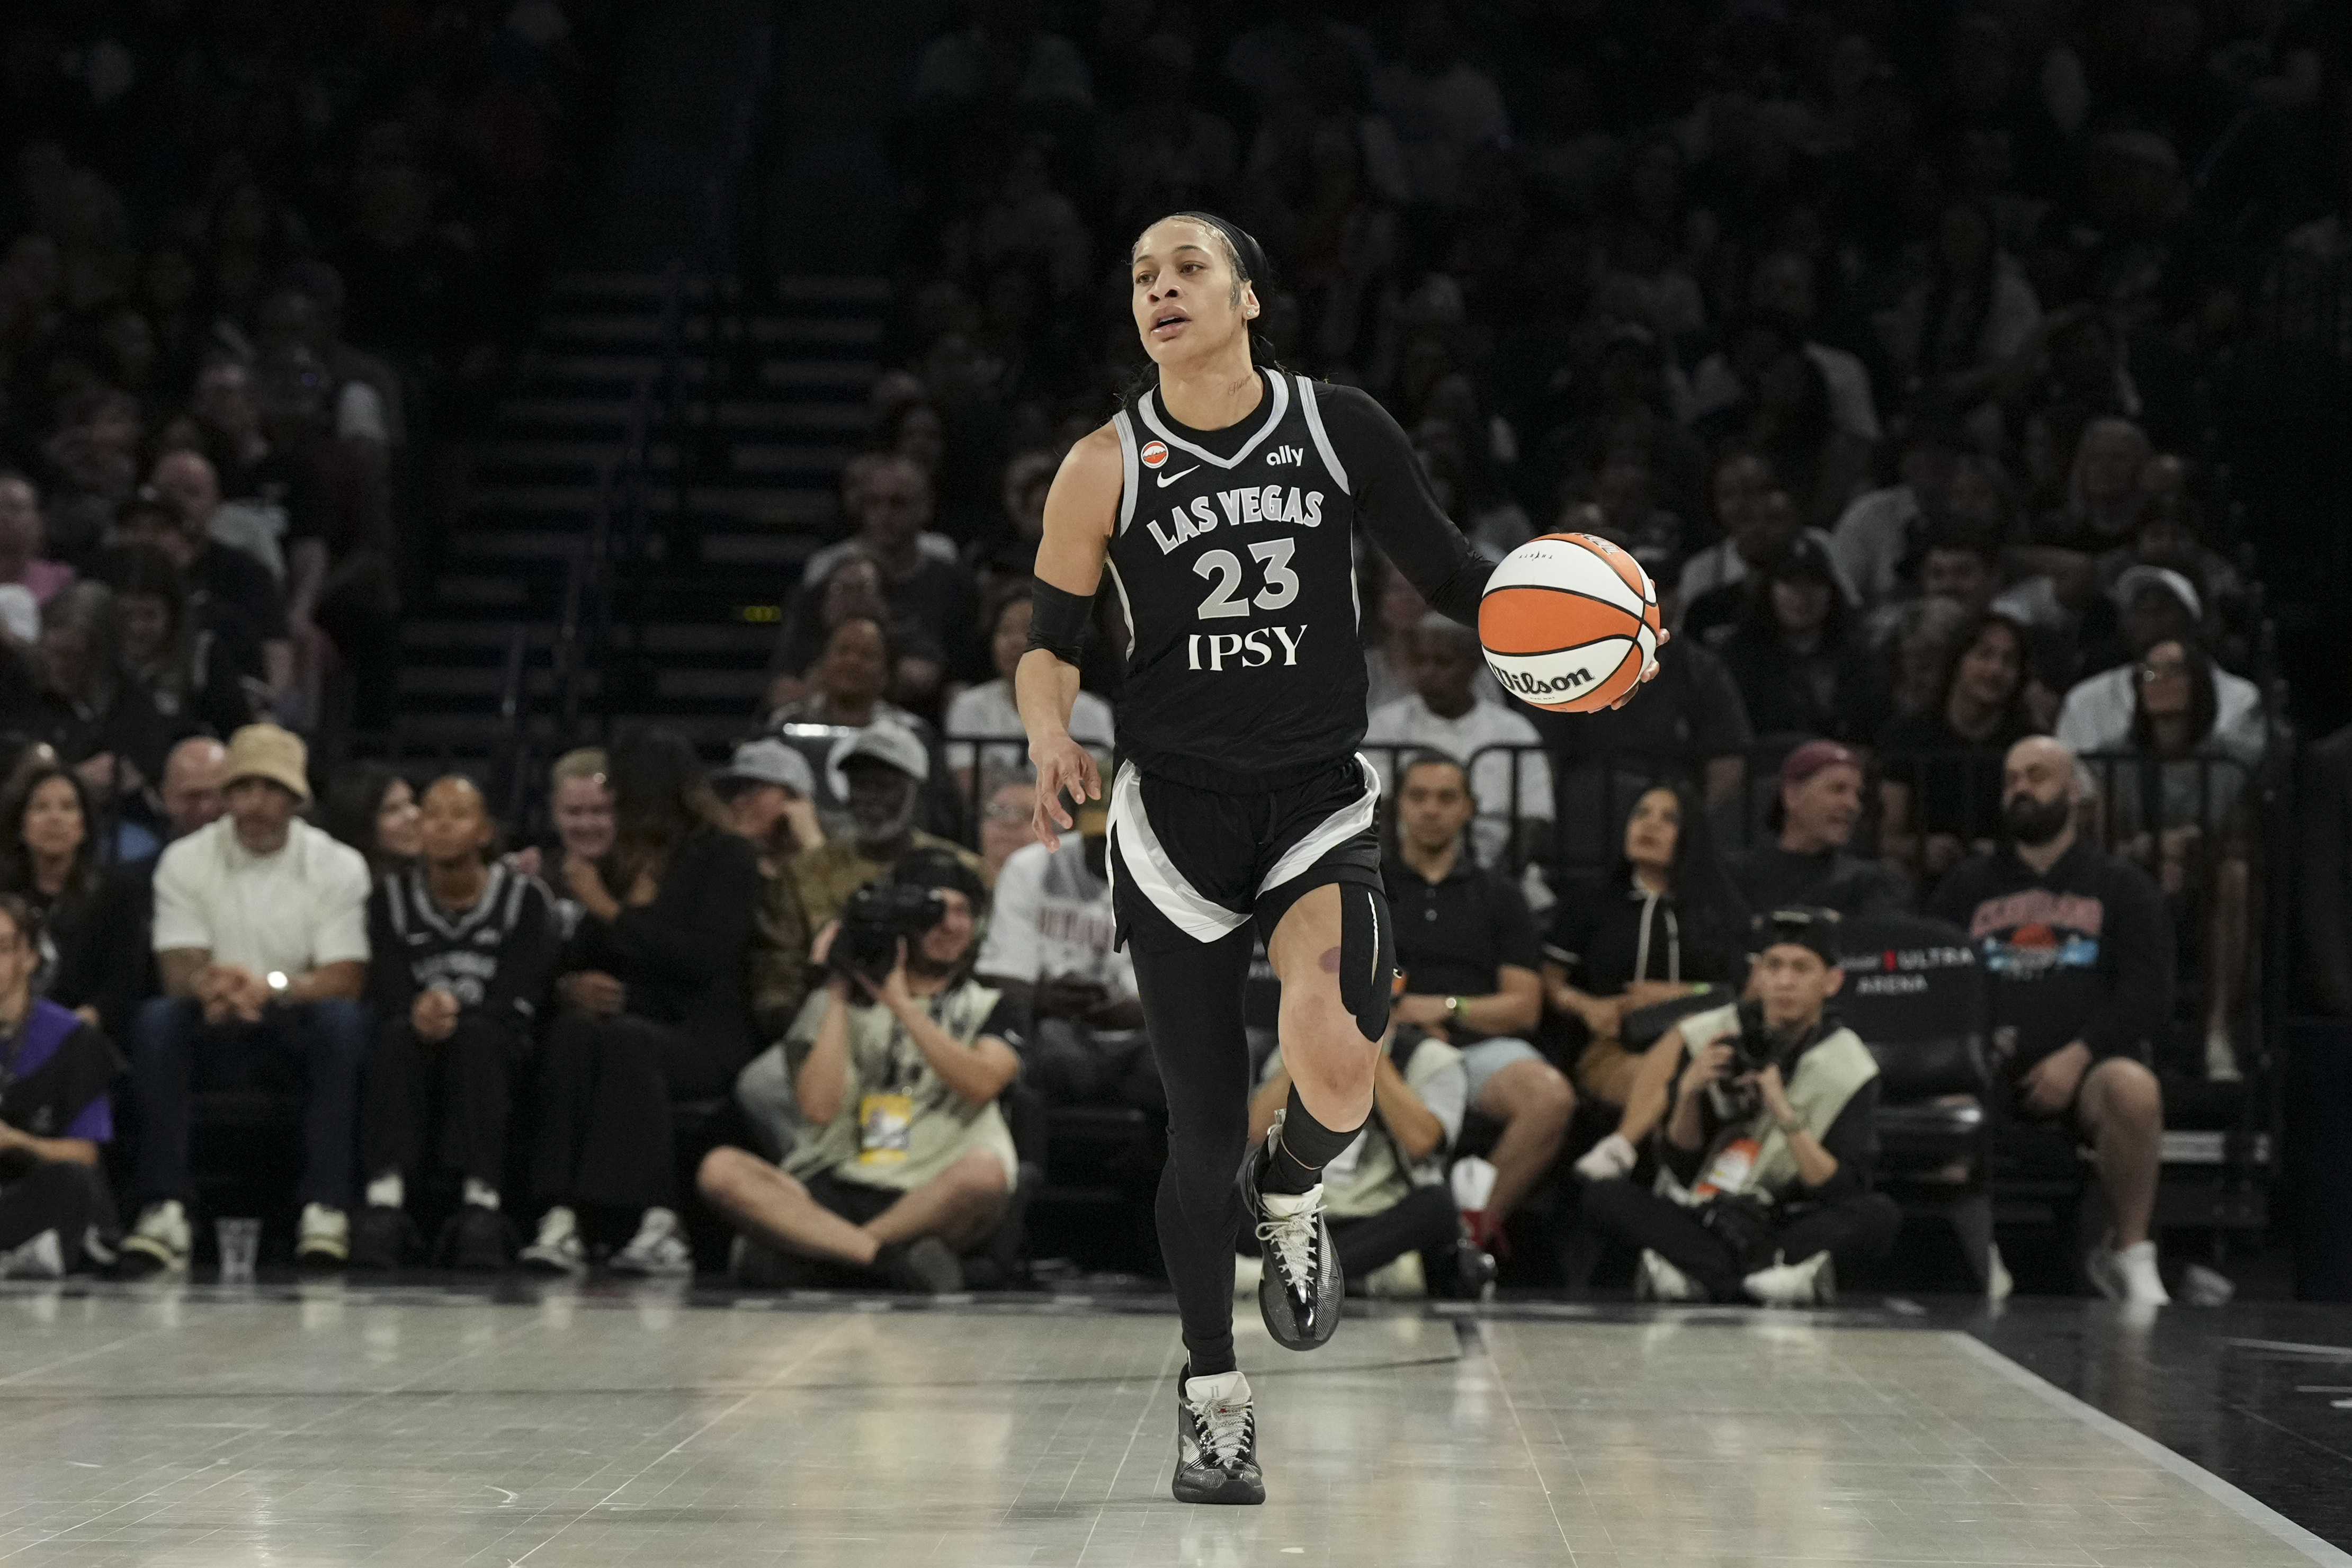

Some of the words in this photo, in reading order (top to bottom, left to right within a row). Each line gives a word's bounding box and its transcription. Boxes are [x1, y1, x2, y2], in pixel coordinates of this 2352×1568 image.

[1266, 445, 1303, 466] ally
[1147, 496, 1218, 554] LAS
[1217, 485, 1324, 527] VEGAS
[1193, 537, 1299, 620] 23
[1188, 624, 1308, 671] IPSY
[1488, 659, 1596, 695] Wilson
